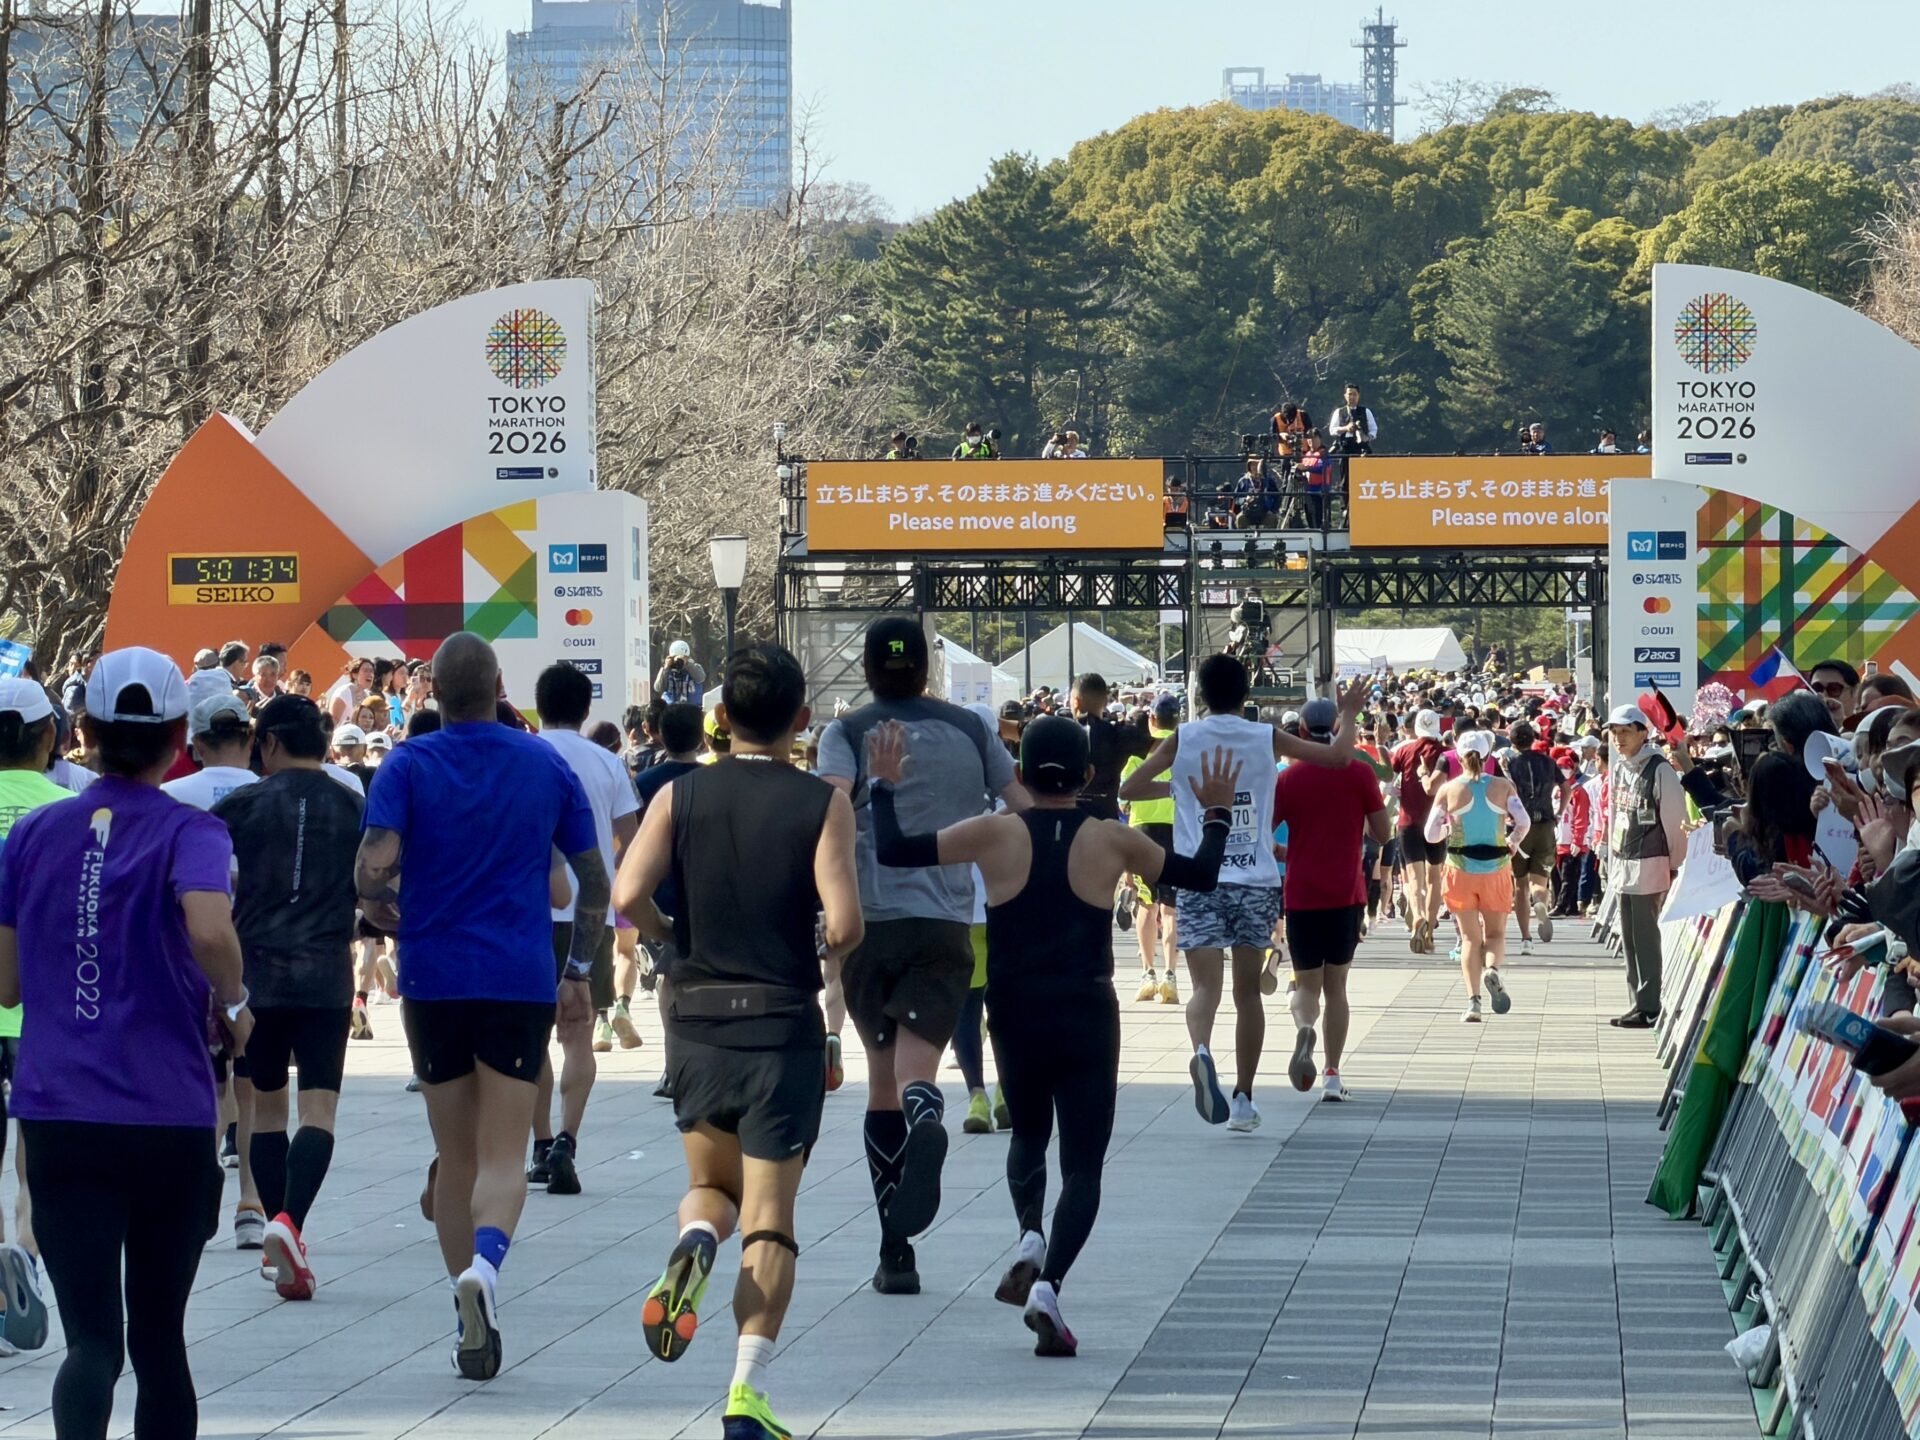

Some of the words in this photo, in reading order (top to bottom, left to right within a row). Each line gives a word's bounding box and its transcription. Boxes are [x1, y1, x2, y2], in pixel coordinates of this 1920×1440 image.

[1676, 381, 1756, 399] TOKYO
[487, 396, 566, 413] TOKYO
[1678, 402, 1755, 413] MARATHON
[488, 417, 565, 428] MARATHON
[1677, 416, 1756, 439] 2026
[488, 431, 566, 454] 2026
[816, 483, 1156, 504] 立ち止まらず、そのままお進みください。
[889, 512, 954, 531] Please
[959, 515, 1015, 530] move
[1020, 511, 1077, 534] along
[1431, 508, 1497, 527] Please
[1502, 511, 1558, 526] move
[1562, 506, 1609, 525] alon
[196, 586, 275, 603] SEIKO
[76, 850, 90, 938] MARATHON
[86, 850, 104, 938] FUKUOKA
[76, 942, 100, 1021] 2022
